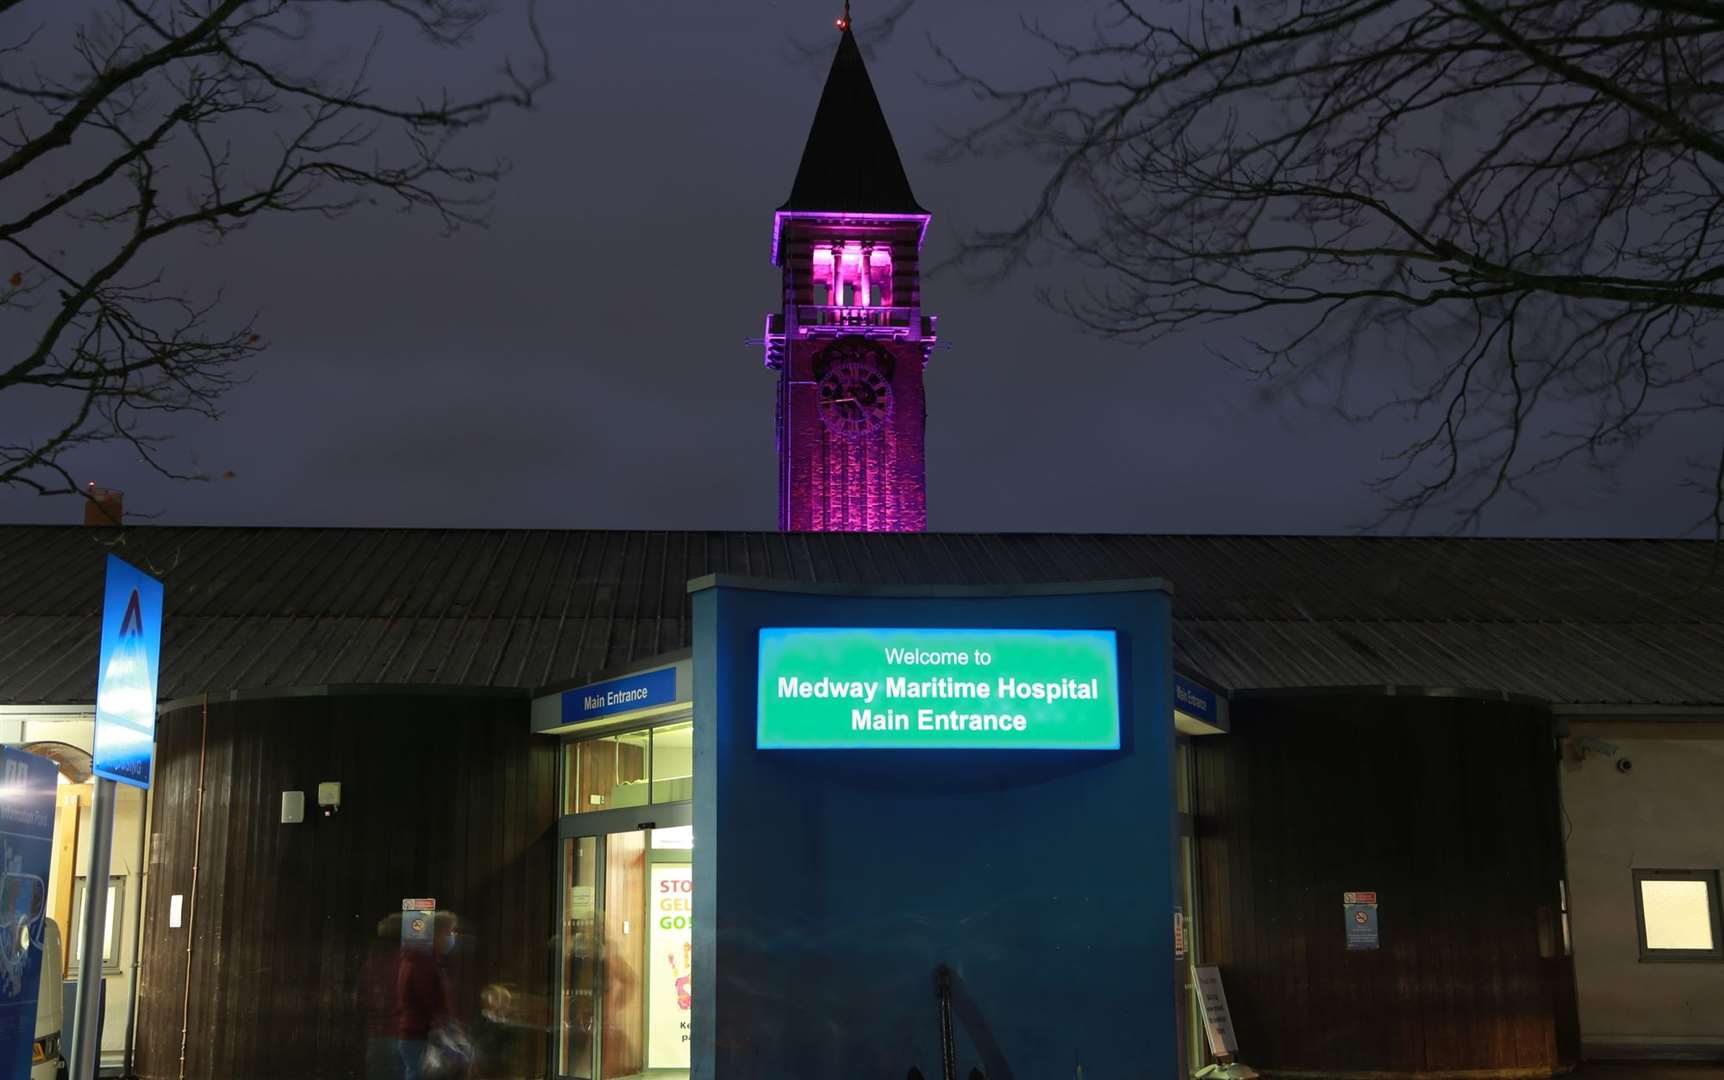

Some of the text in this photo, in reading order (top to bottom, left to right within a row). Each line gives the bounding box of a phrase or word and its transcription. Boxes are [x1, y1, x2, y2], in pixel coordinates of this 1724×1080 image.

[884, 647, 992, 666] Welcome to
[585, 687, 648, 711] Main Entrance
[777, 676, 1099, 704] Medway Maritime Hospital
[851, 708, 1028, 731] Main Entrance
